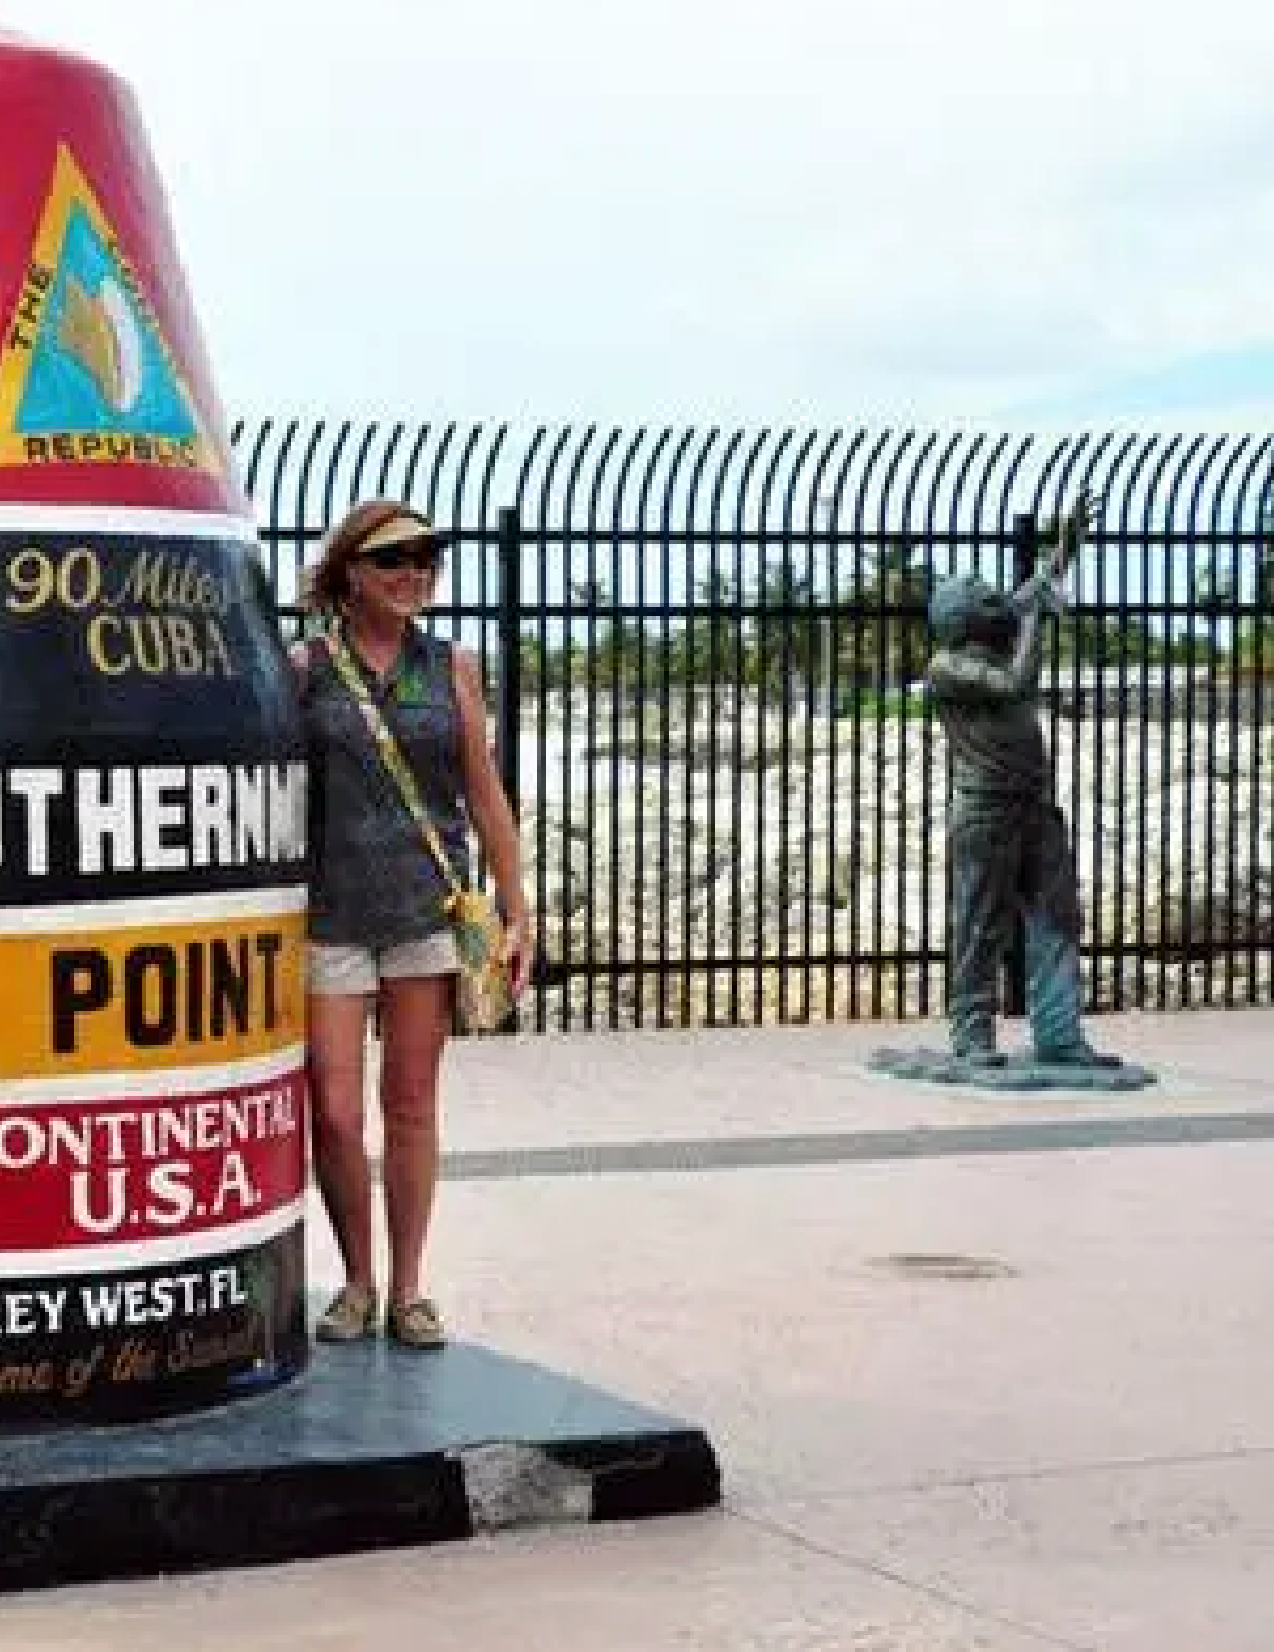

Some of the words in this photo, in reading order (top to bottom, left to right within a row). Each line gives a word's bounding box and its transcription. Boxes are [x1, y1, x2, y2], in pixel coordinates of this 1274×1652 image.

[10, 263, 53, 350] THE
[4, 547, 104, 614] 90
[86, 614, 233, 677] CUBA
[50, 934, 283, 1054] POINT
